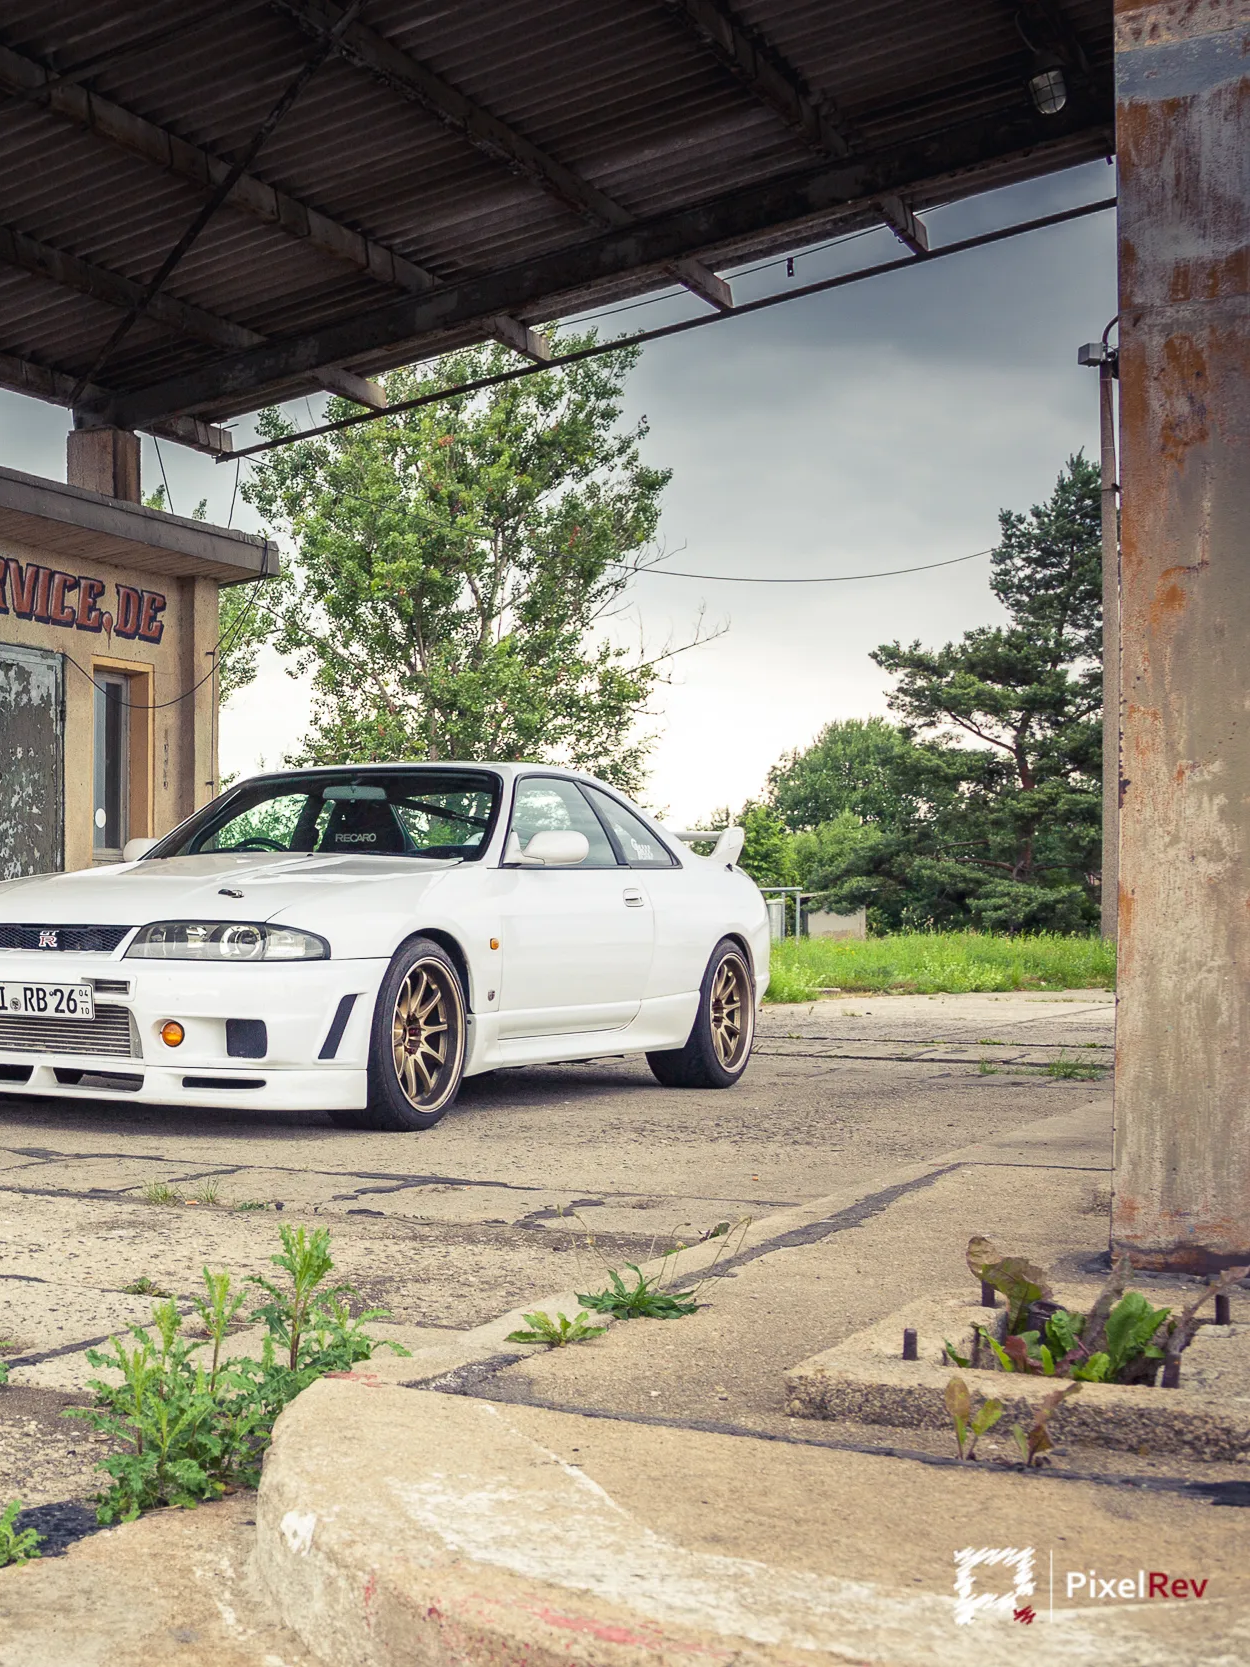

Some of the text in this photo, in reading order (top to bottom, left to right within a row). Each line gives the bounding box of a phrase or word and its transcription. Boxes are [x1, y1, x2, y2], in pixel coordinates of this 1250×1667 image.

[335, 833, 377, 842] RECARO
[38, 936, 58, 948] R
[78, 989, 89, 997] 04
[23, 987, 48, 1012] RB
[53, 988, 78, 1014] 26
[80, 1007, 90, 1015] 10
